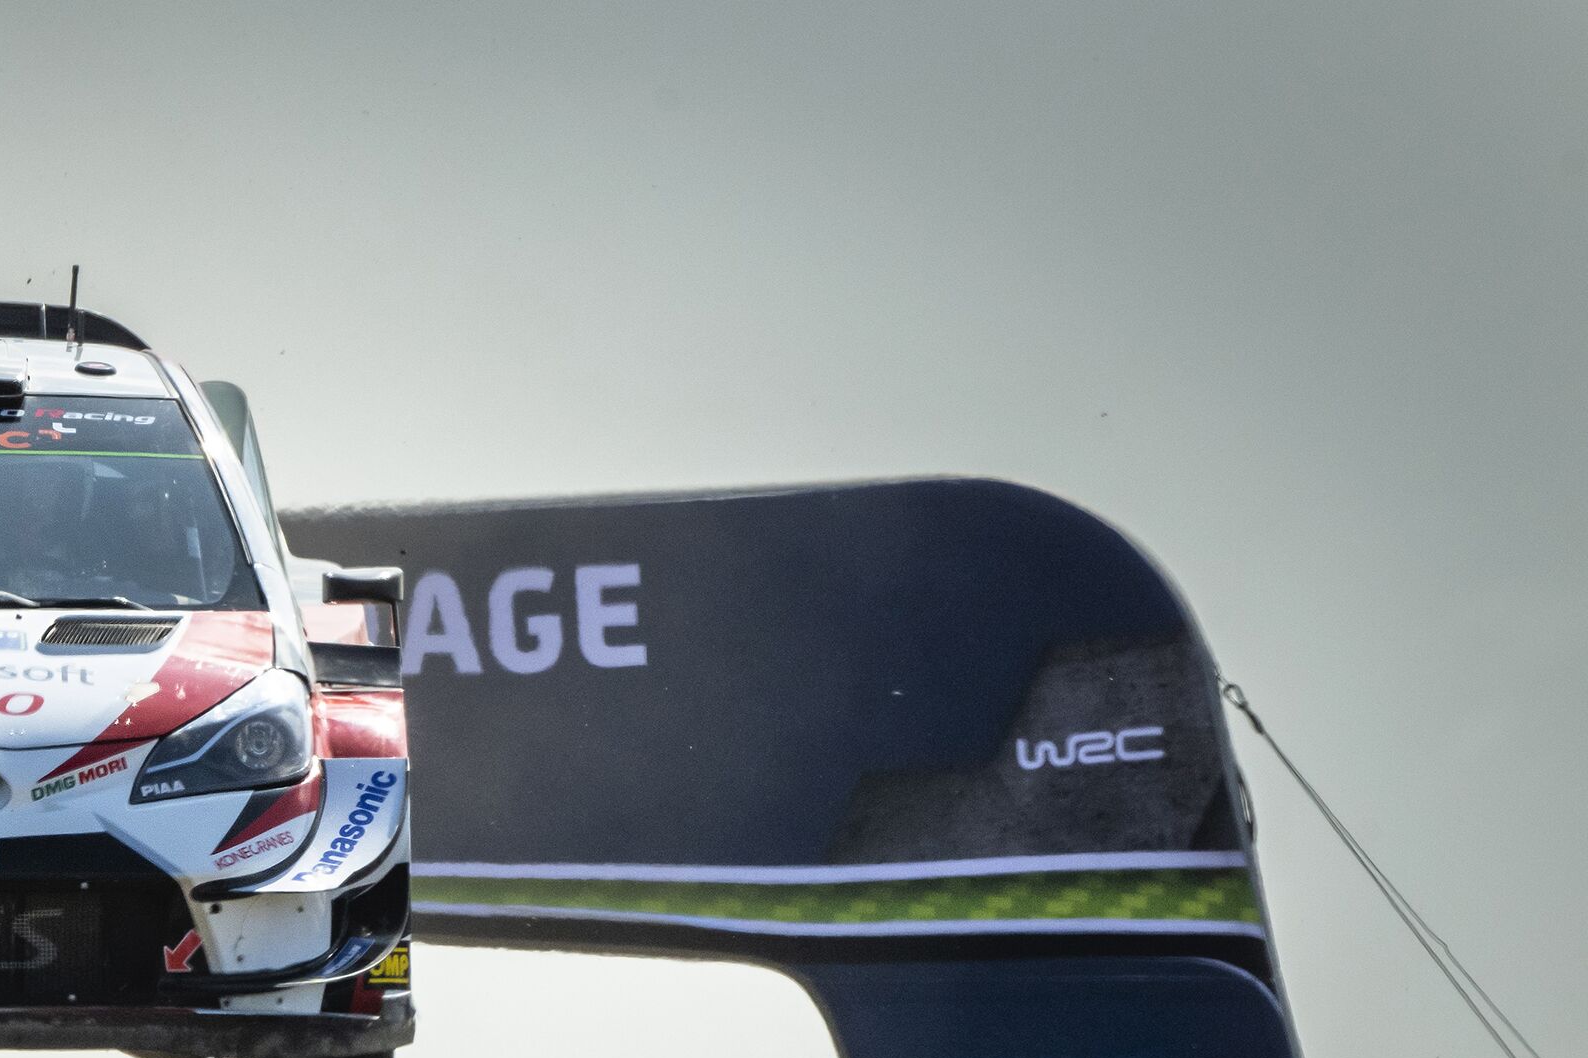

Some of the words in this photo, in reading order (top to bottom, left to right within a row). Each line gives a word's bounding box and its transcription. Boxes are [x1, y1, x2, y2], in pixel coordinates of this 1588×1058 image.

[34, 408, 156, 425] Racing
[402, 563, 648, 675] AGE
[31, 774, 77, 801] DMG
[79, 756, 129, 785] MORI
[140, 780, 186, 798] PIAA
[214, 830, 295, 870] KONECRANES
